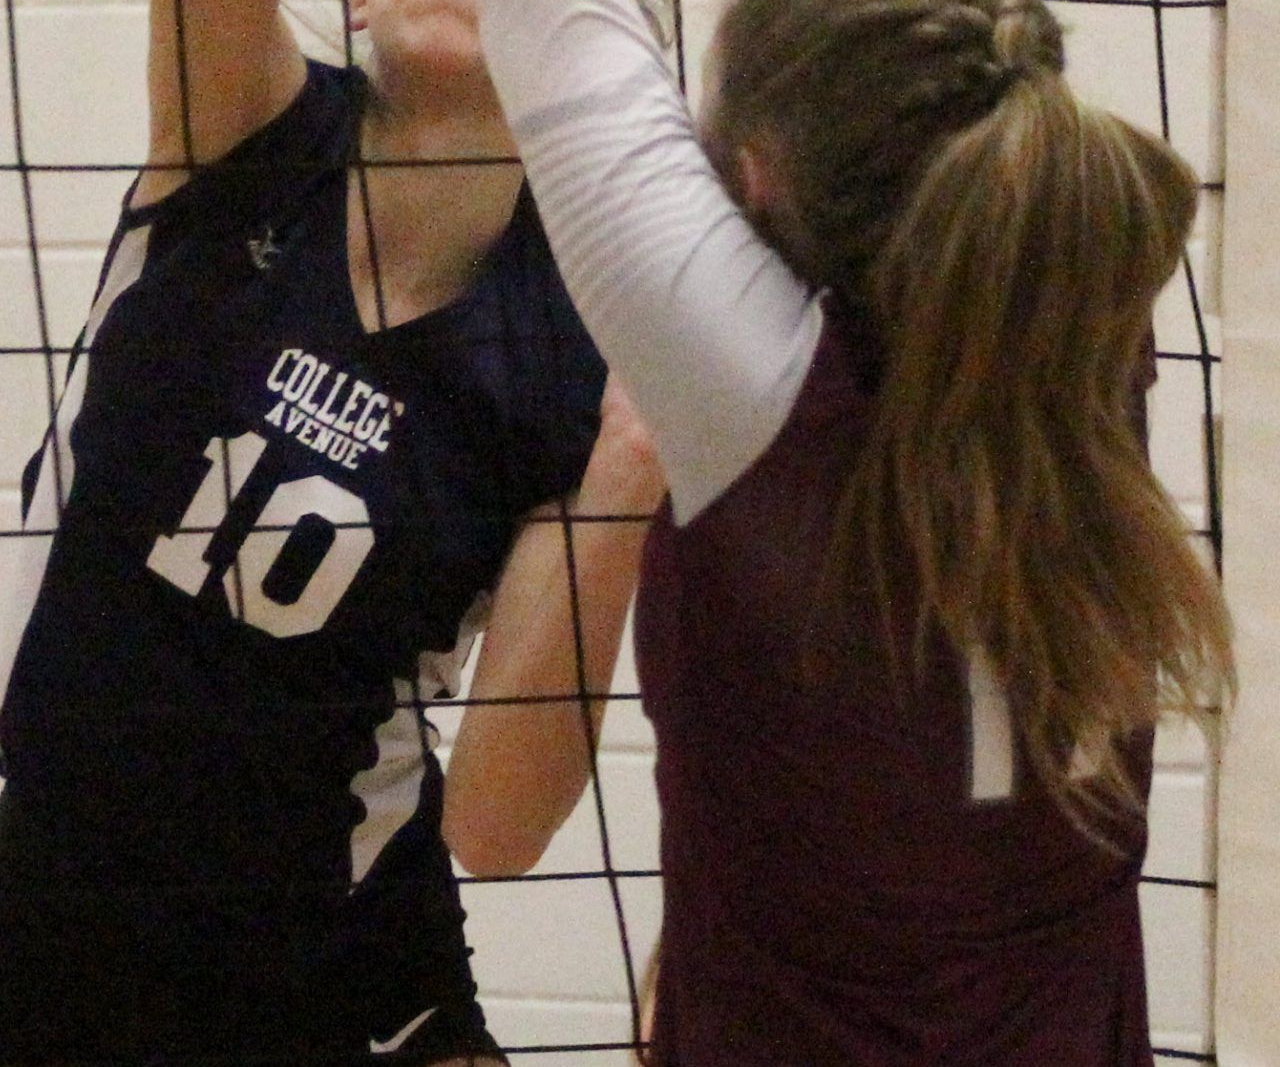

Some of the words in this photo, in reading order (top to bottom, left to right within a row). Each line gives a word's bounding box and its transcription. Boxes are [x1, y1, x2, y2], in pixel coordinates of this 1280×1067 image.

[264, 401, 368, 471] AVENUE
[267, 348, 404, 452] COLLEGE
[146, 431, 376, 639] 10
